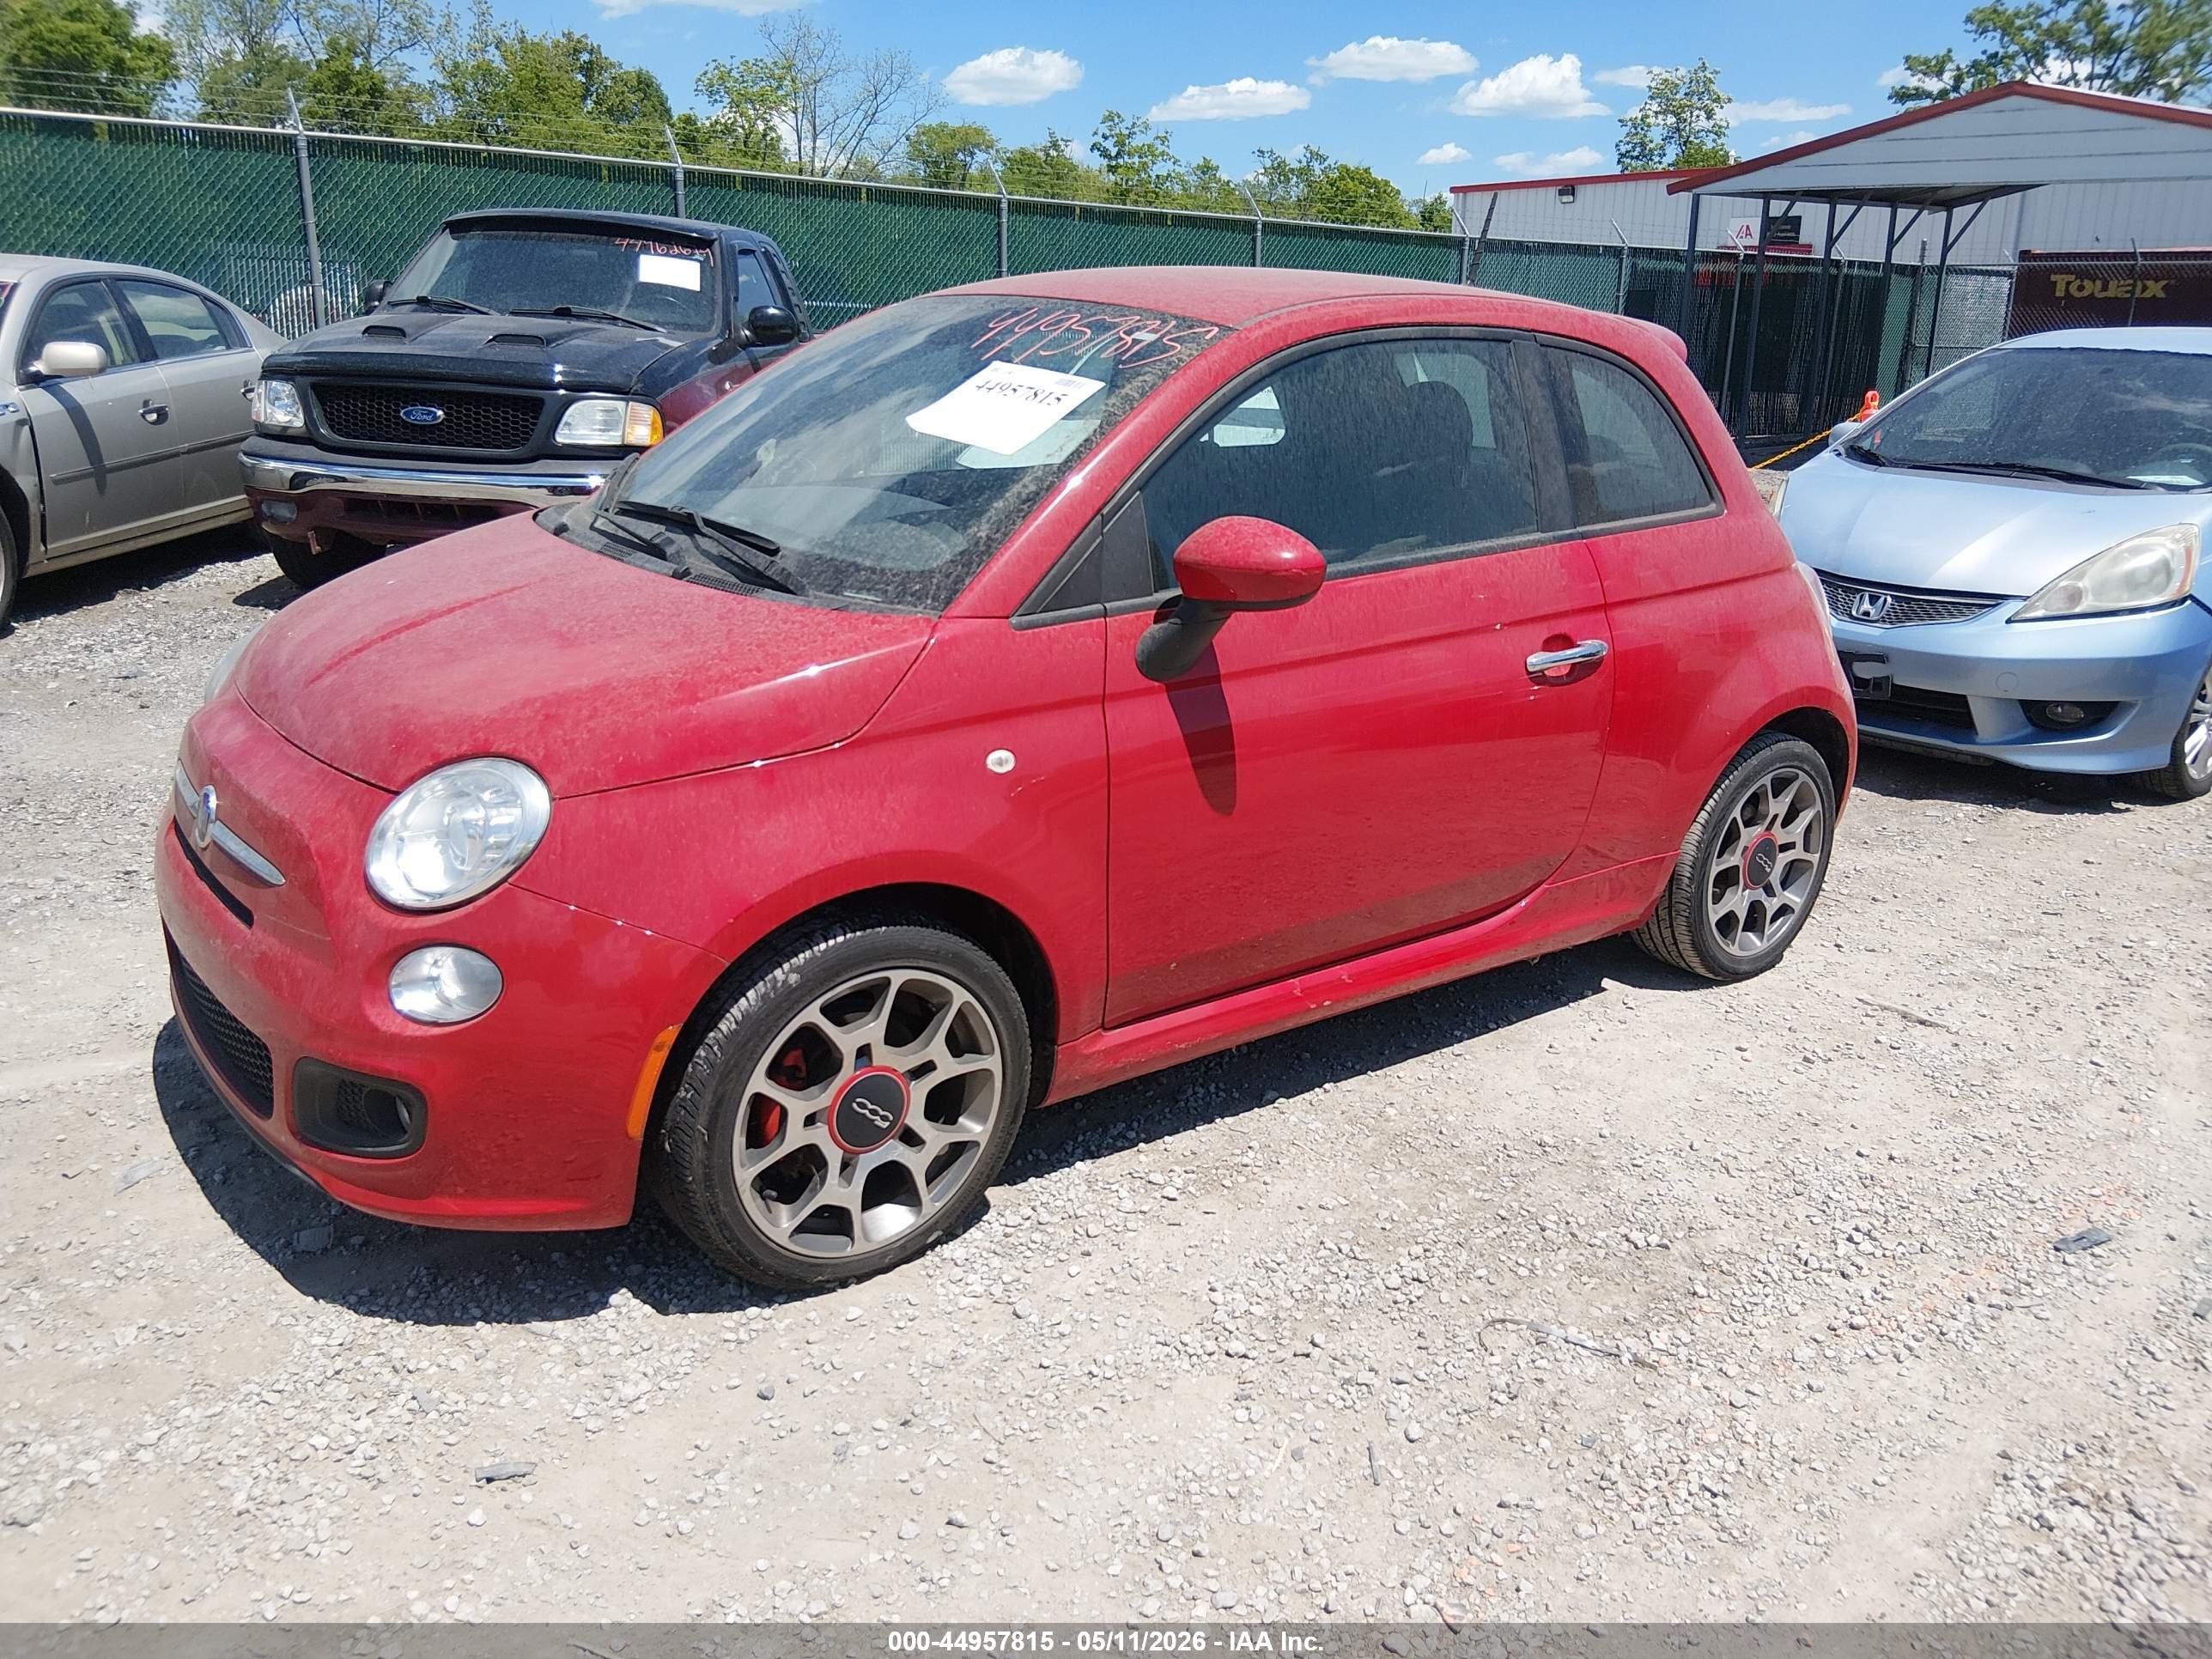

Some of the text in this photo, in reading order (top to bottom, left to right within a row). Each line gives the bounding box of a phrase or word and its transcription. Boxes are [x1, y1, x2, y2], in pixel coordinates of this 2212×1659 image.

[970, 307, 1219, 368] 44957815
[975, 380, 1069, 406] 44957815
[410, 410, 434, 421] Ford
